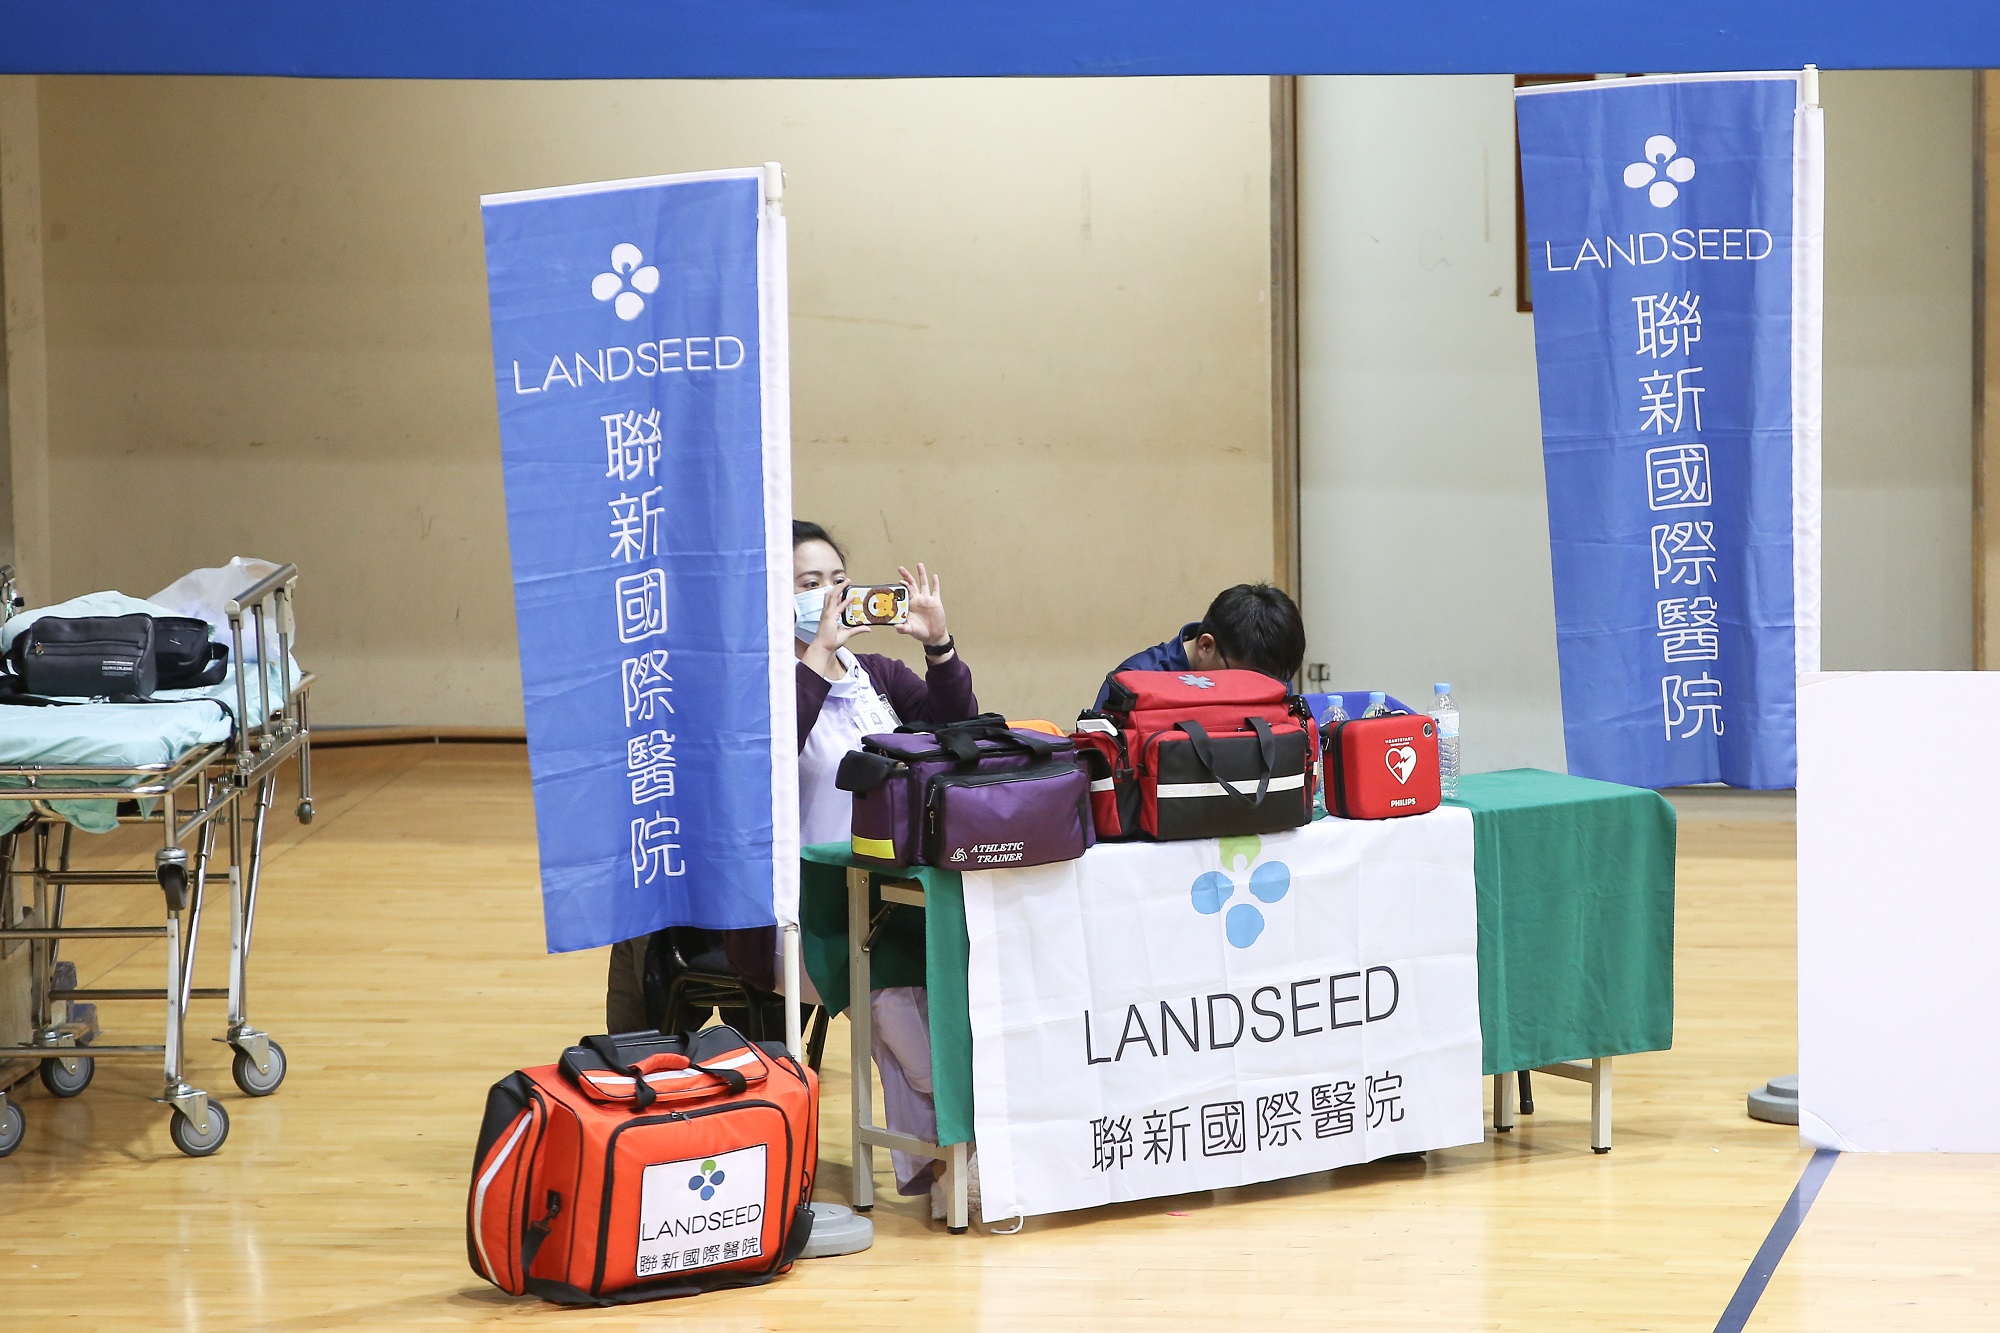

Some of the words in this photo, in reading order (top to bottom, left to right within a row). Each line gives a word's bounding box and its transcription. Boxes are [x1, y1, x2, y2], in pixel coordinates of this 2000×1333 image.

[1544, 228, 1774, 272] LANDSEED
[512, 334, 745, 395] LANDSEED
[1631, 290, 1725, 741] 聯新國際醫院
[600, 407, 686, 890] 聯新國際醫院
[1390, 797, 1416, 808] PHILIPS
[970, 841, 1024, 853] ATHLETIC
[977, 852, 1023, 863] TRAINER
[1084, 965, 1400, 1065] LANDSEED
[1090, 1070, 1405, 1172] 聯新國際醫院
[641, 1203, 761, 1241] LANDSEED
[639, 1236, 758, 1273] 聯新國際醫院
